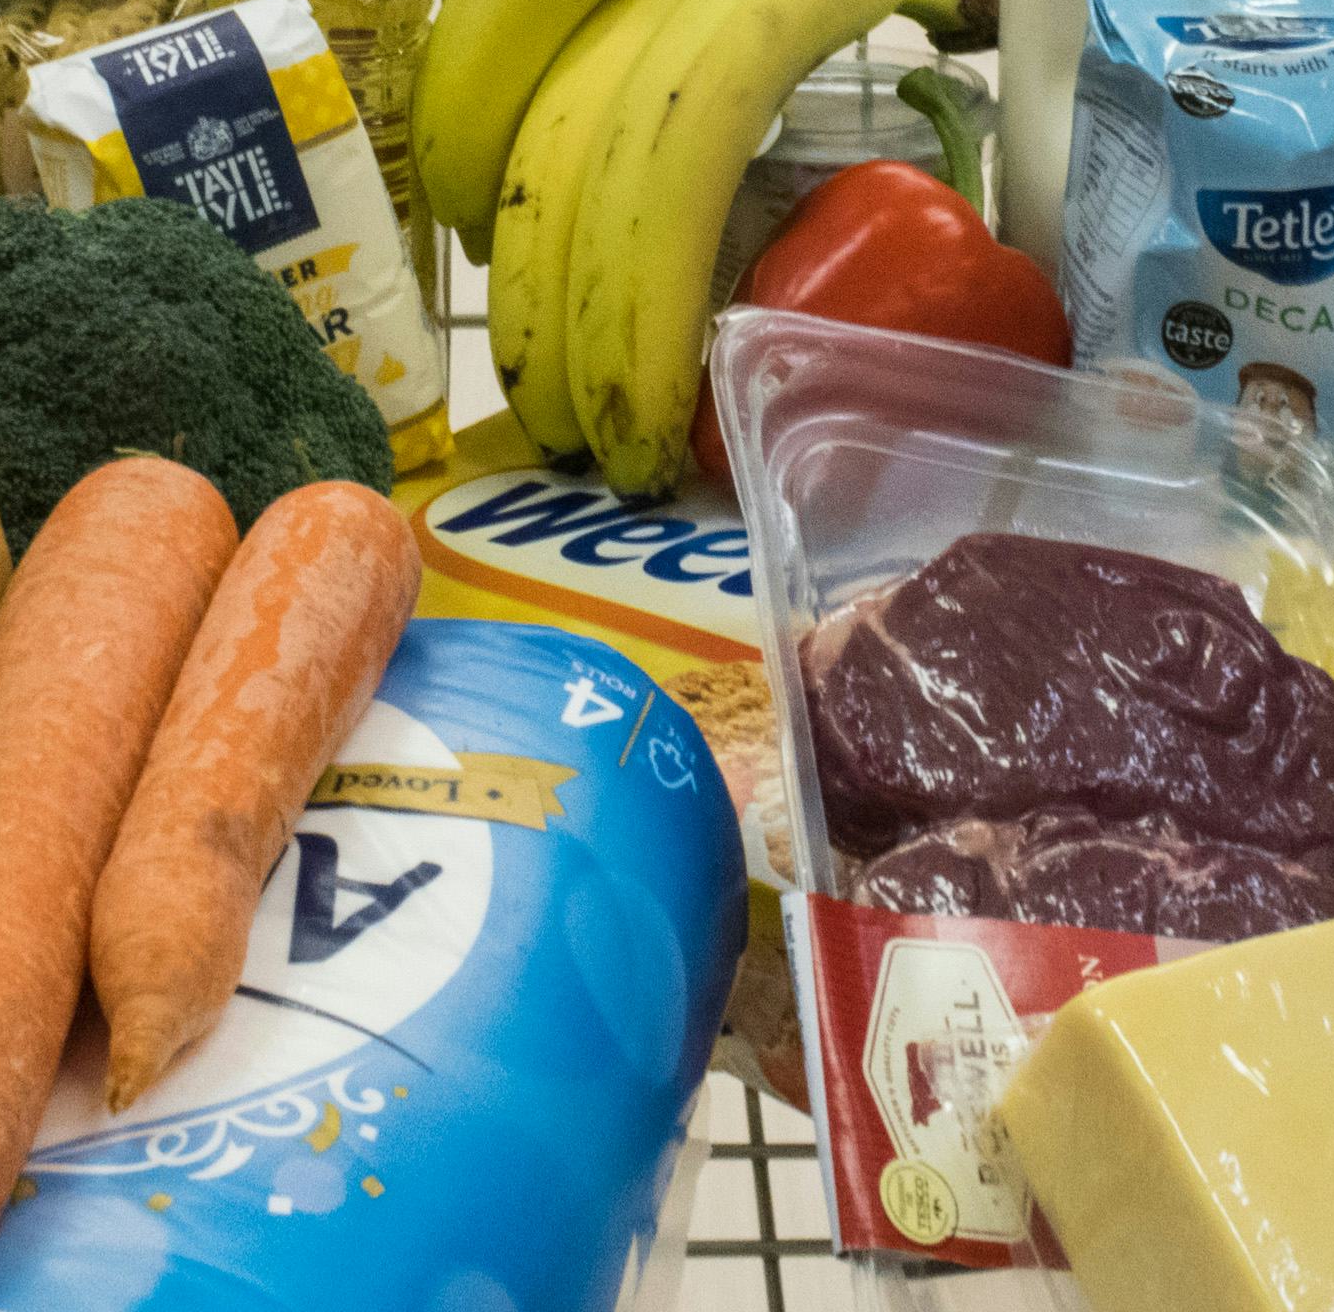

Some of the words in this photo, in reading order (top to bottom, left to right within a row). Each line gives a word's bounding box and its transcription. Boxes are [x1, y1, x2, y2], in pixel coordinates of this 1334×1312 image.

[1222, 58, 1279, 79] starts
[1285, 57, 1327, 78] with
[1165, 319, 1232, 353] taste
[433, 480, 755, 597] Wee
[569, 659, 637, 700] ROLLS
[561, 676, 624, 729] 4
[334, 770, 463, 804] Loved
